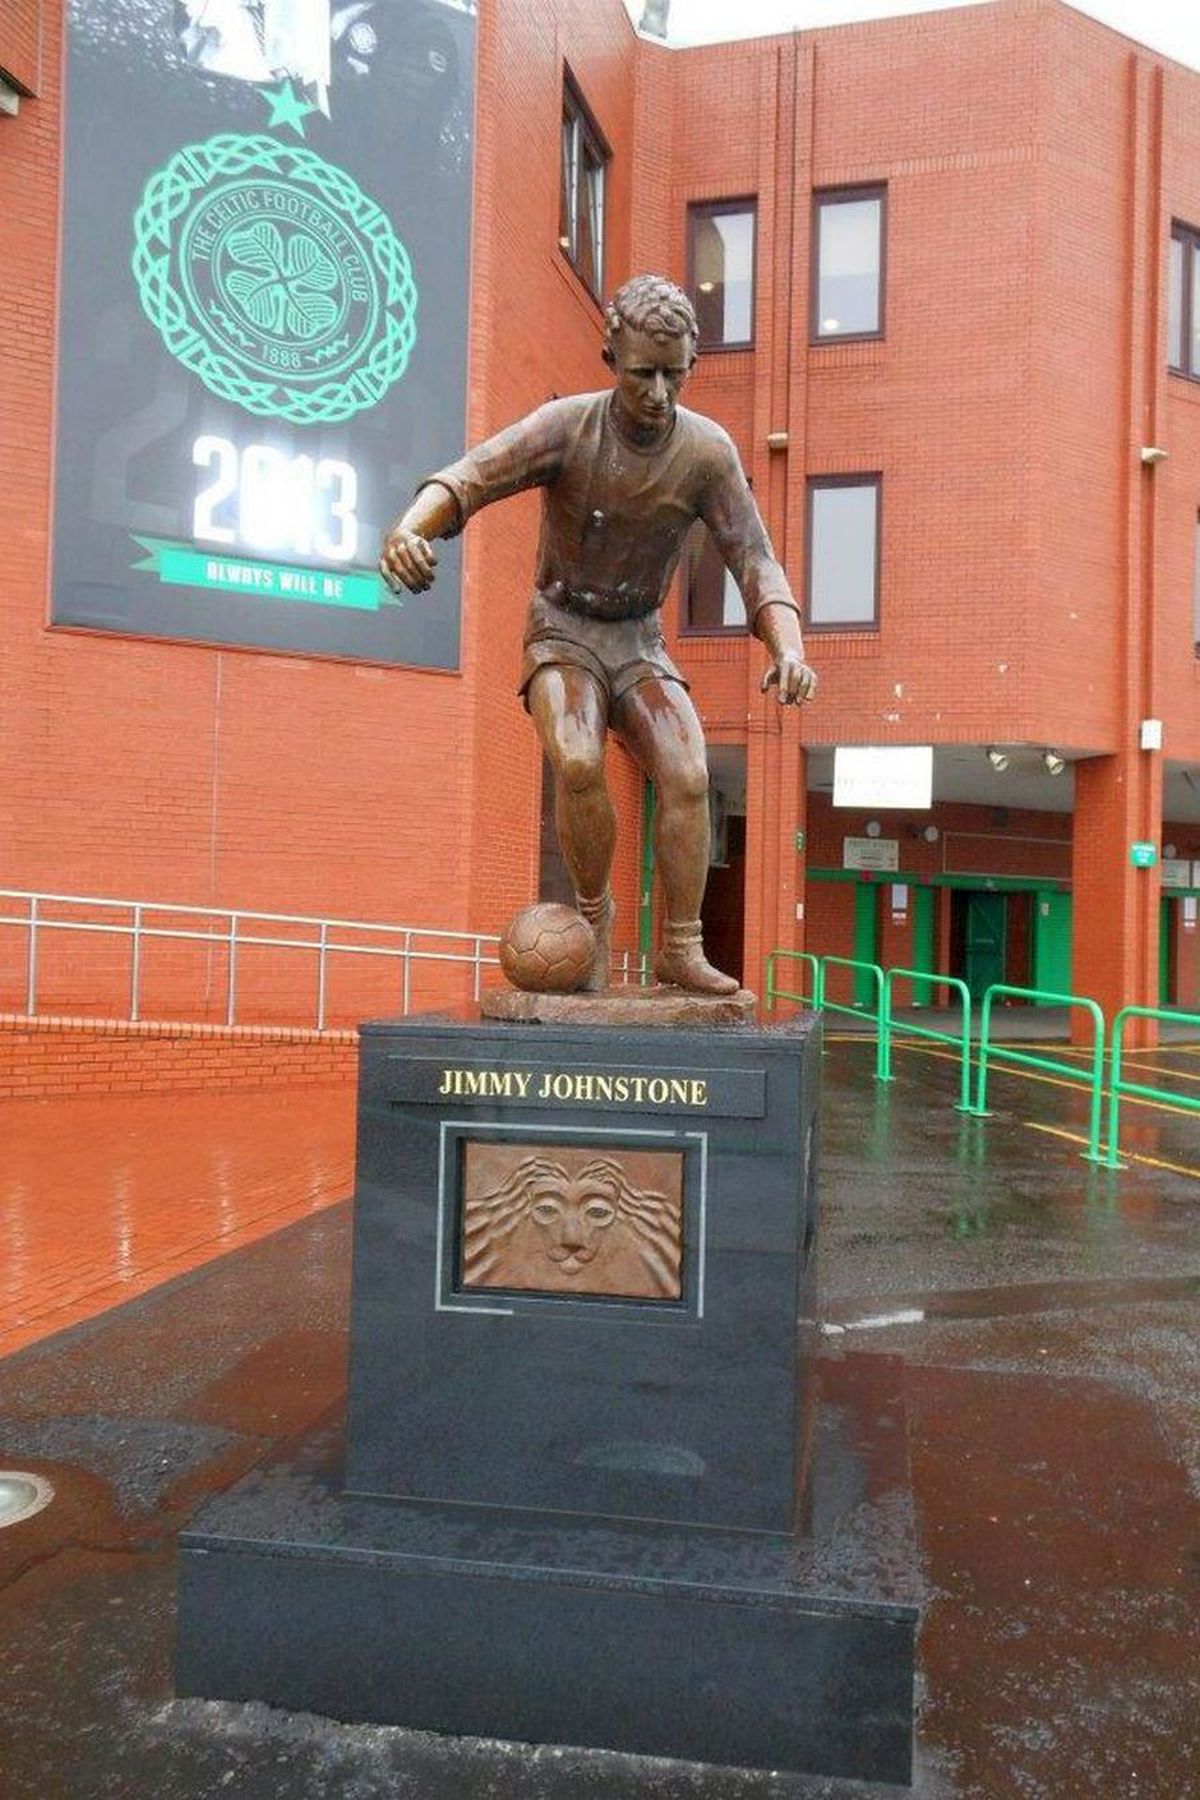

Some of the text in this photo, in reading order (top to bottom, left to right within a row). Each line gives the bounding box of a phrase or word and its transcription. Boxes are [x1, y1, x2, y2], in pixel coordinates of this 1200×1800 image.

[192, 190, 369, 302] THE CELTIC FOOTBALL CLUB
[263, 344, 301, 369] 1888
[192, 435, 358, 560] 2013
[206, 561, 345, 598] ALWAYS WILL BE
[439, 1070, 708, 1106] JIMMY JOHNSTONE
